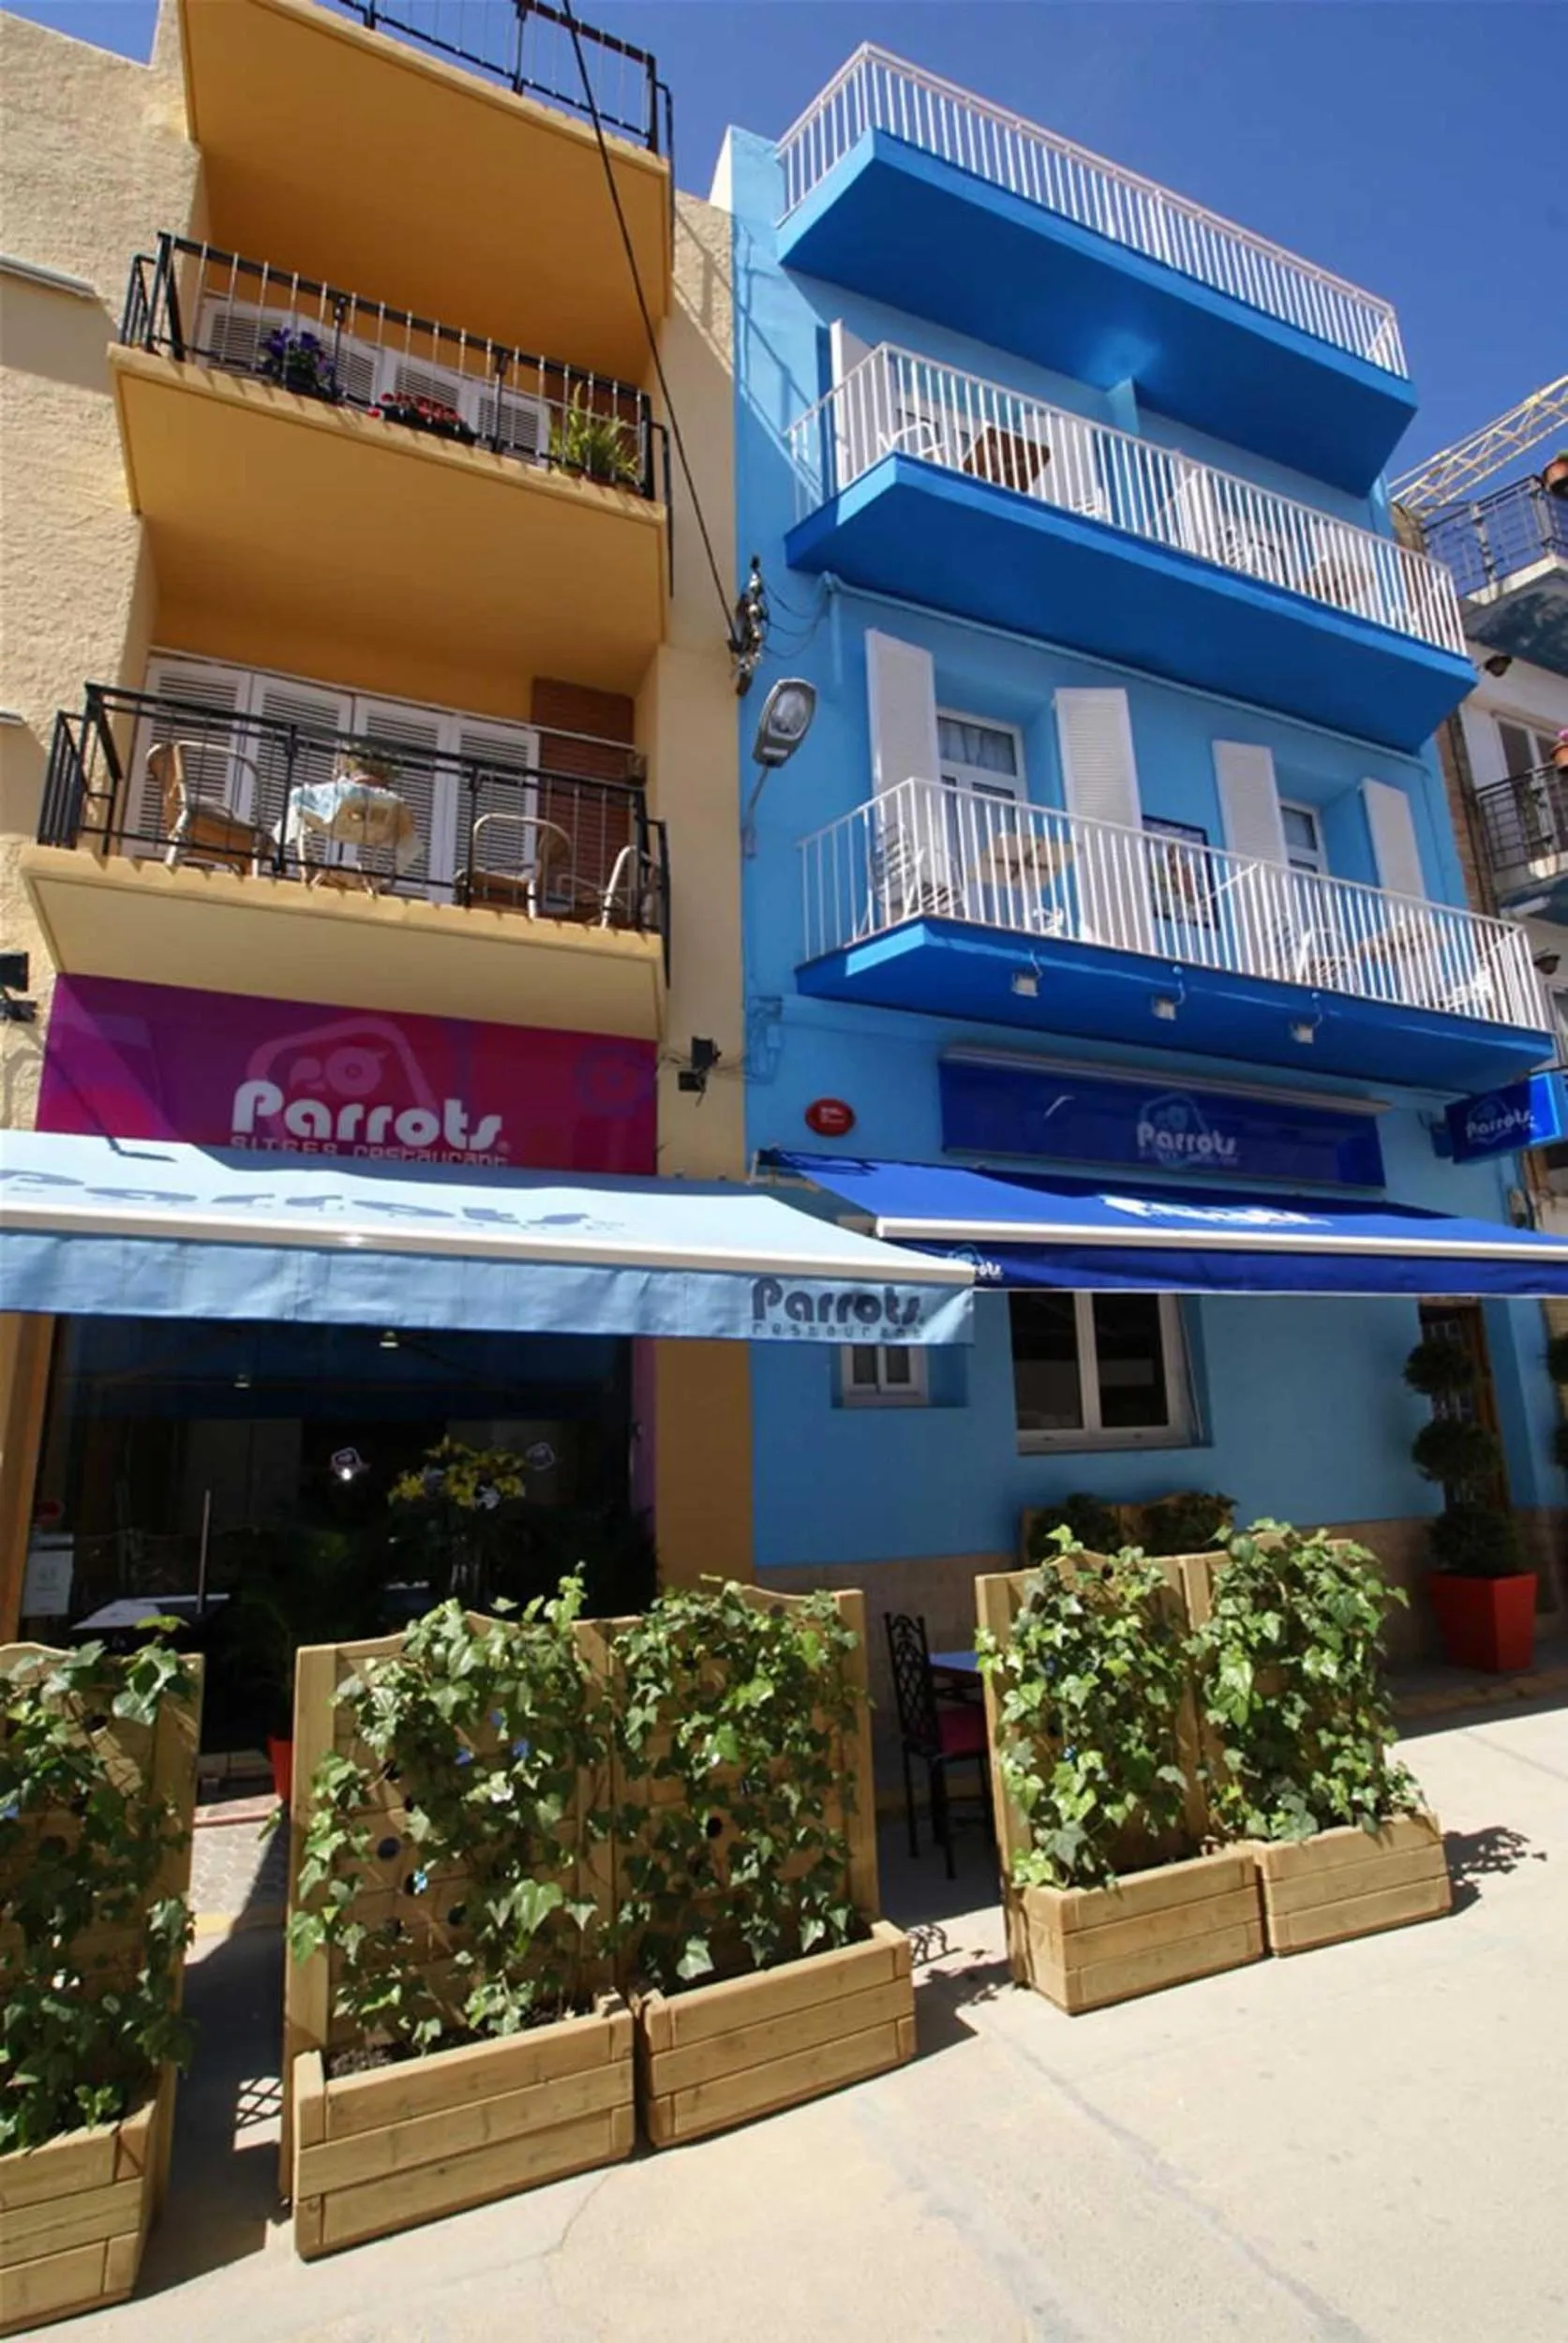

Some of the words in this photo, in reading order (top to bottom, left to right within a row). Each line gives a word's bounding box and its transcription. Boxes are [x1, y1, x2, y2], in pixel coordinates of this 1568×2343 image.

[232, 1081, 502, 1151] Parrots
[1466, 1108, 1533, 1139] Parrots
[1136, 1121, 1236, 1156] Parrots
[753, 1277, 920, 1324] Parrots
[753, 1322, 922, 1339] restaurant
